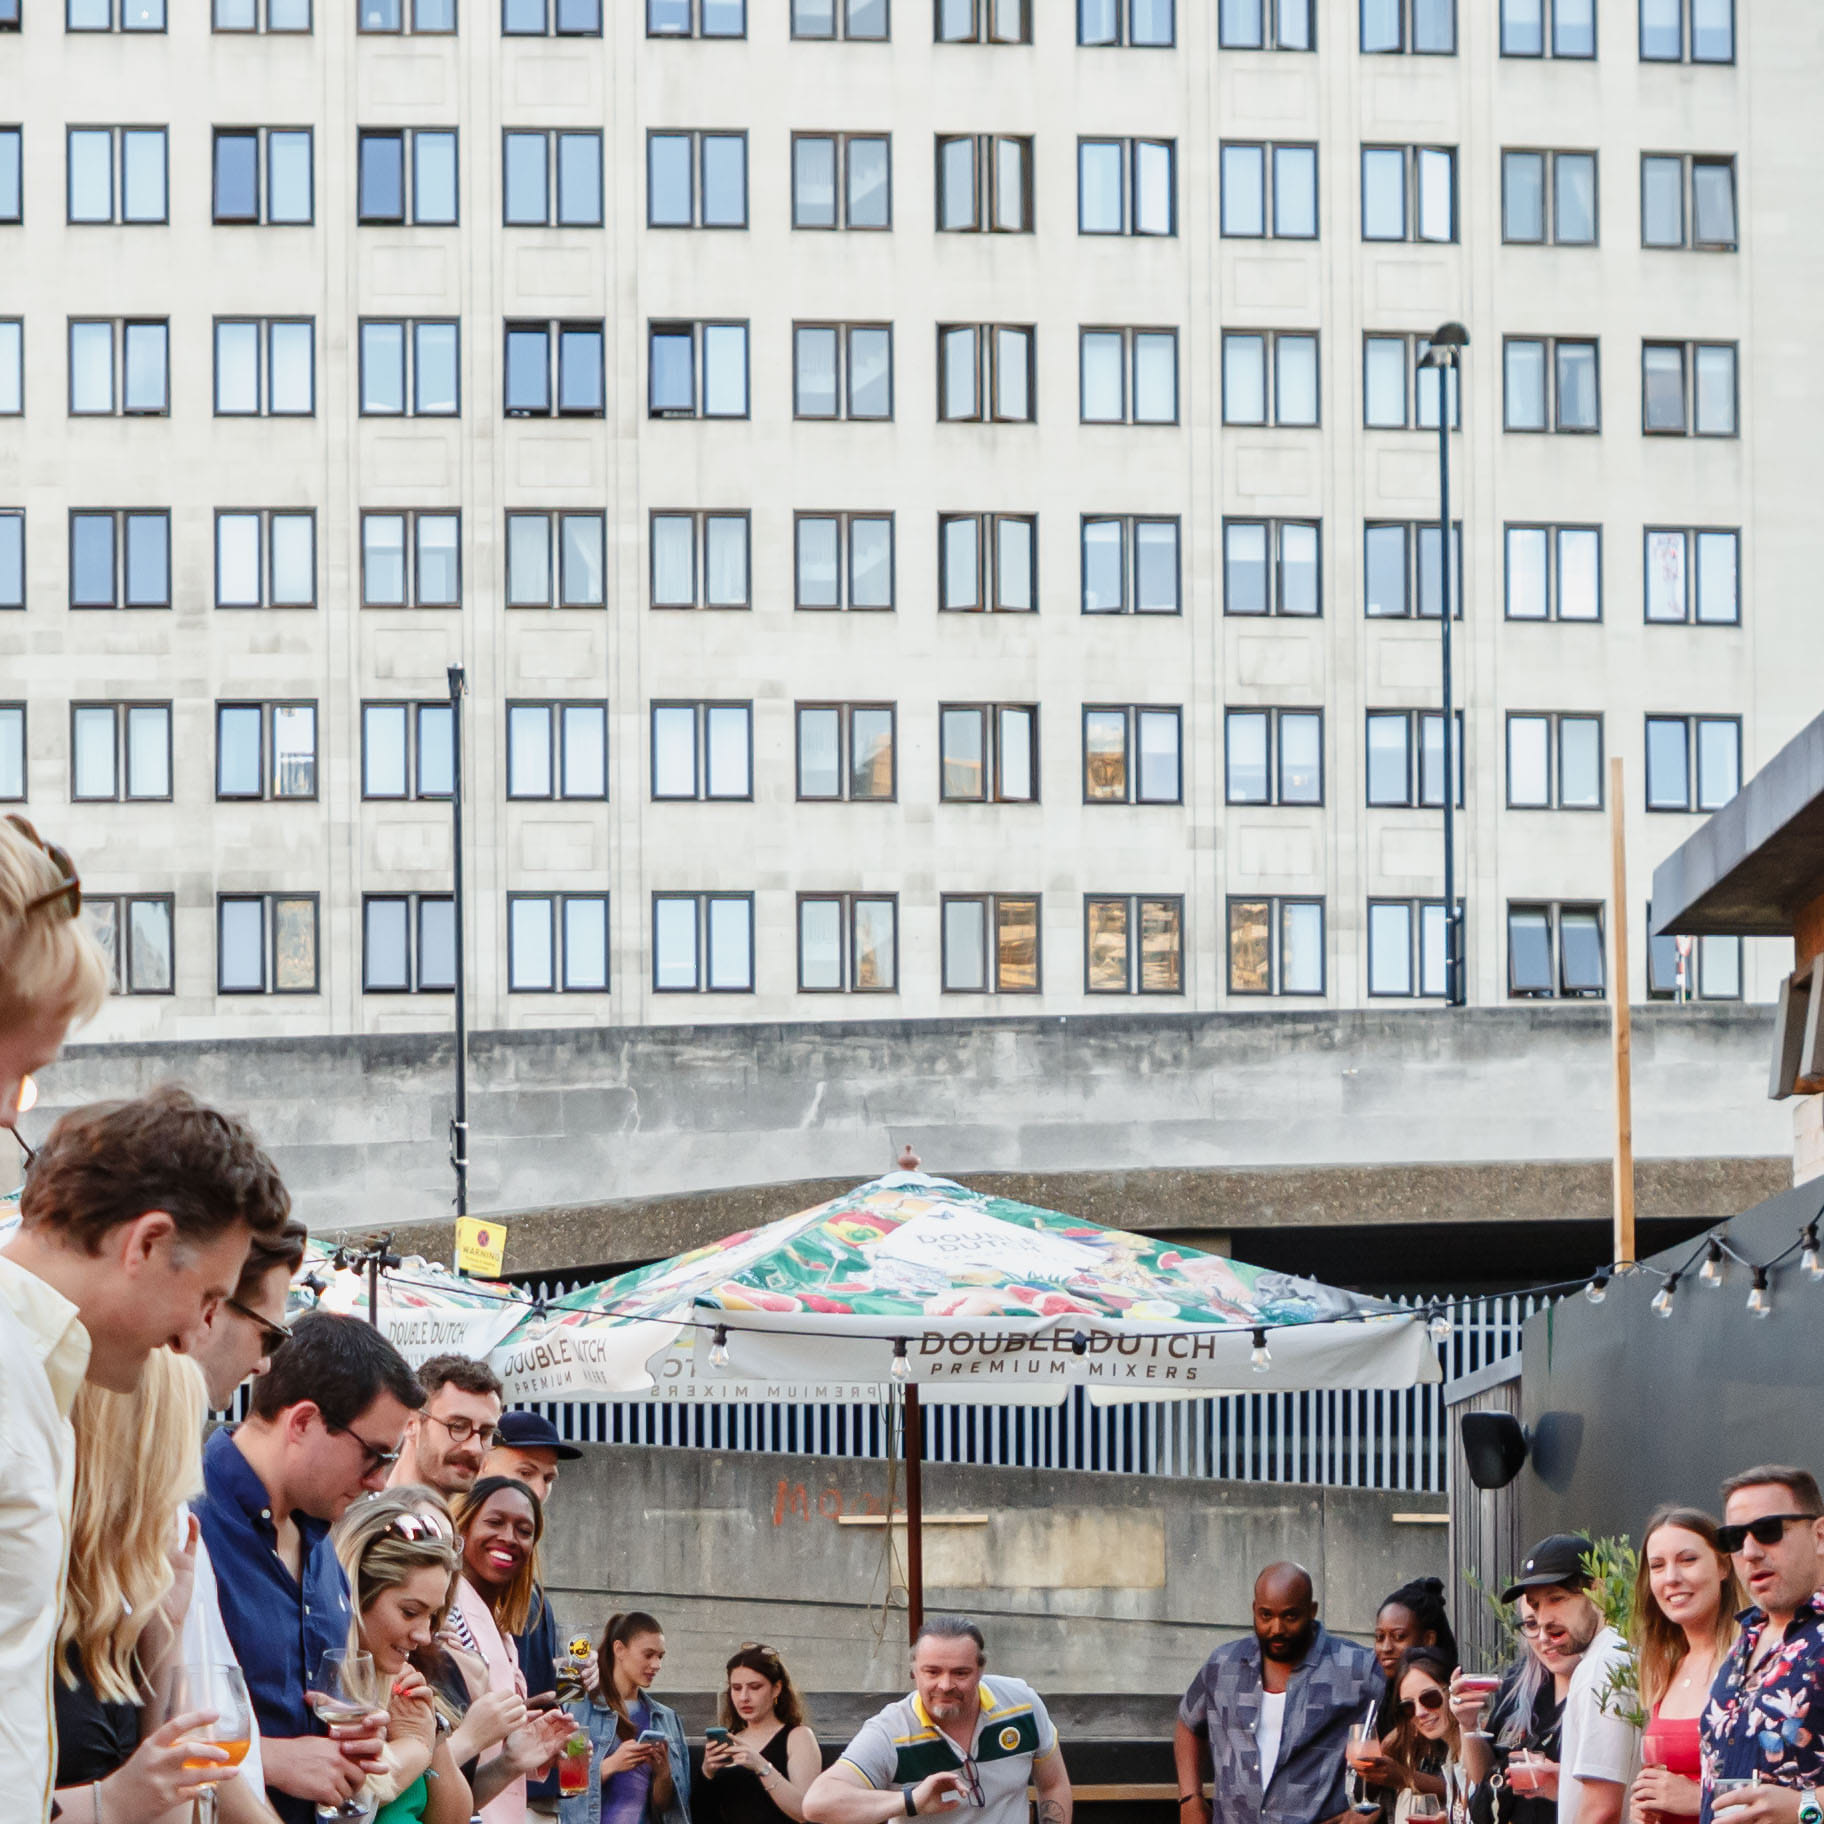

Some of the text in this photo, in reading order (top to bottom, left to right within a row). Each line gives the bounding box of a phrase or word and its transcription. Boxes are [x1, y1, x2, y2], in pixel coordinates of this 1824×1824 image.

[463, 1246, 501, 1262] WARNING
[389, 1320, 468, 1345] DOUBLE DUTCH
[919, 1327, 1216, 1360] DOUBLE DUTCH
[504, 1338, 573, 1377] DOUBLE
[930, 1358, 1198, 1380] PREMIUM MIXERS
[514, 1370, 572, 1395] PREMIUM
